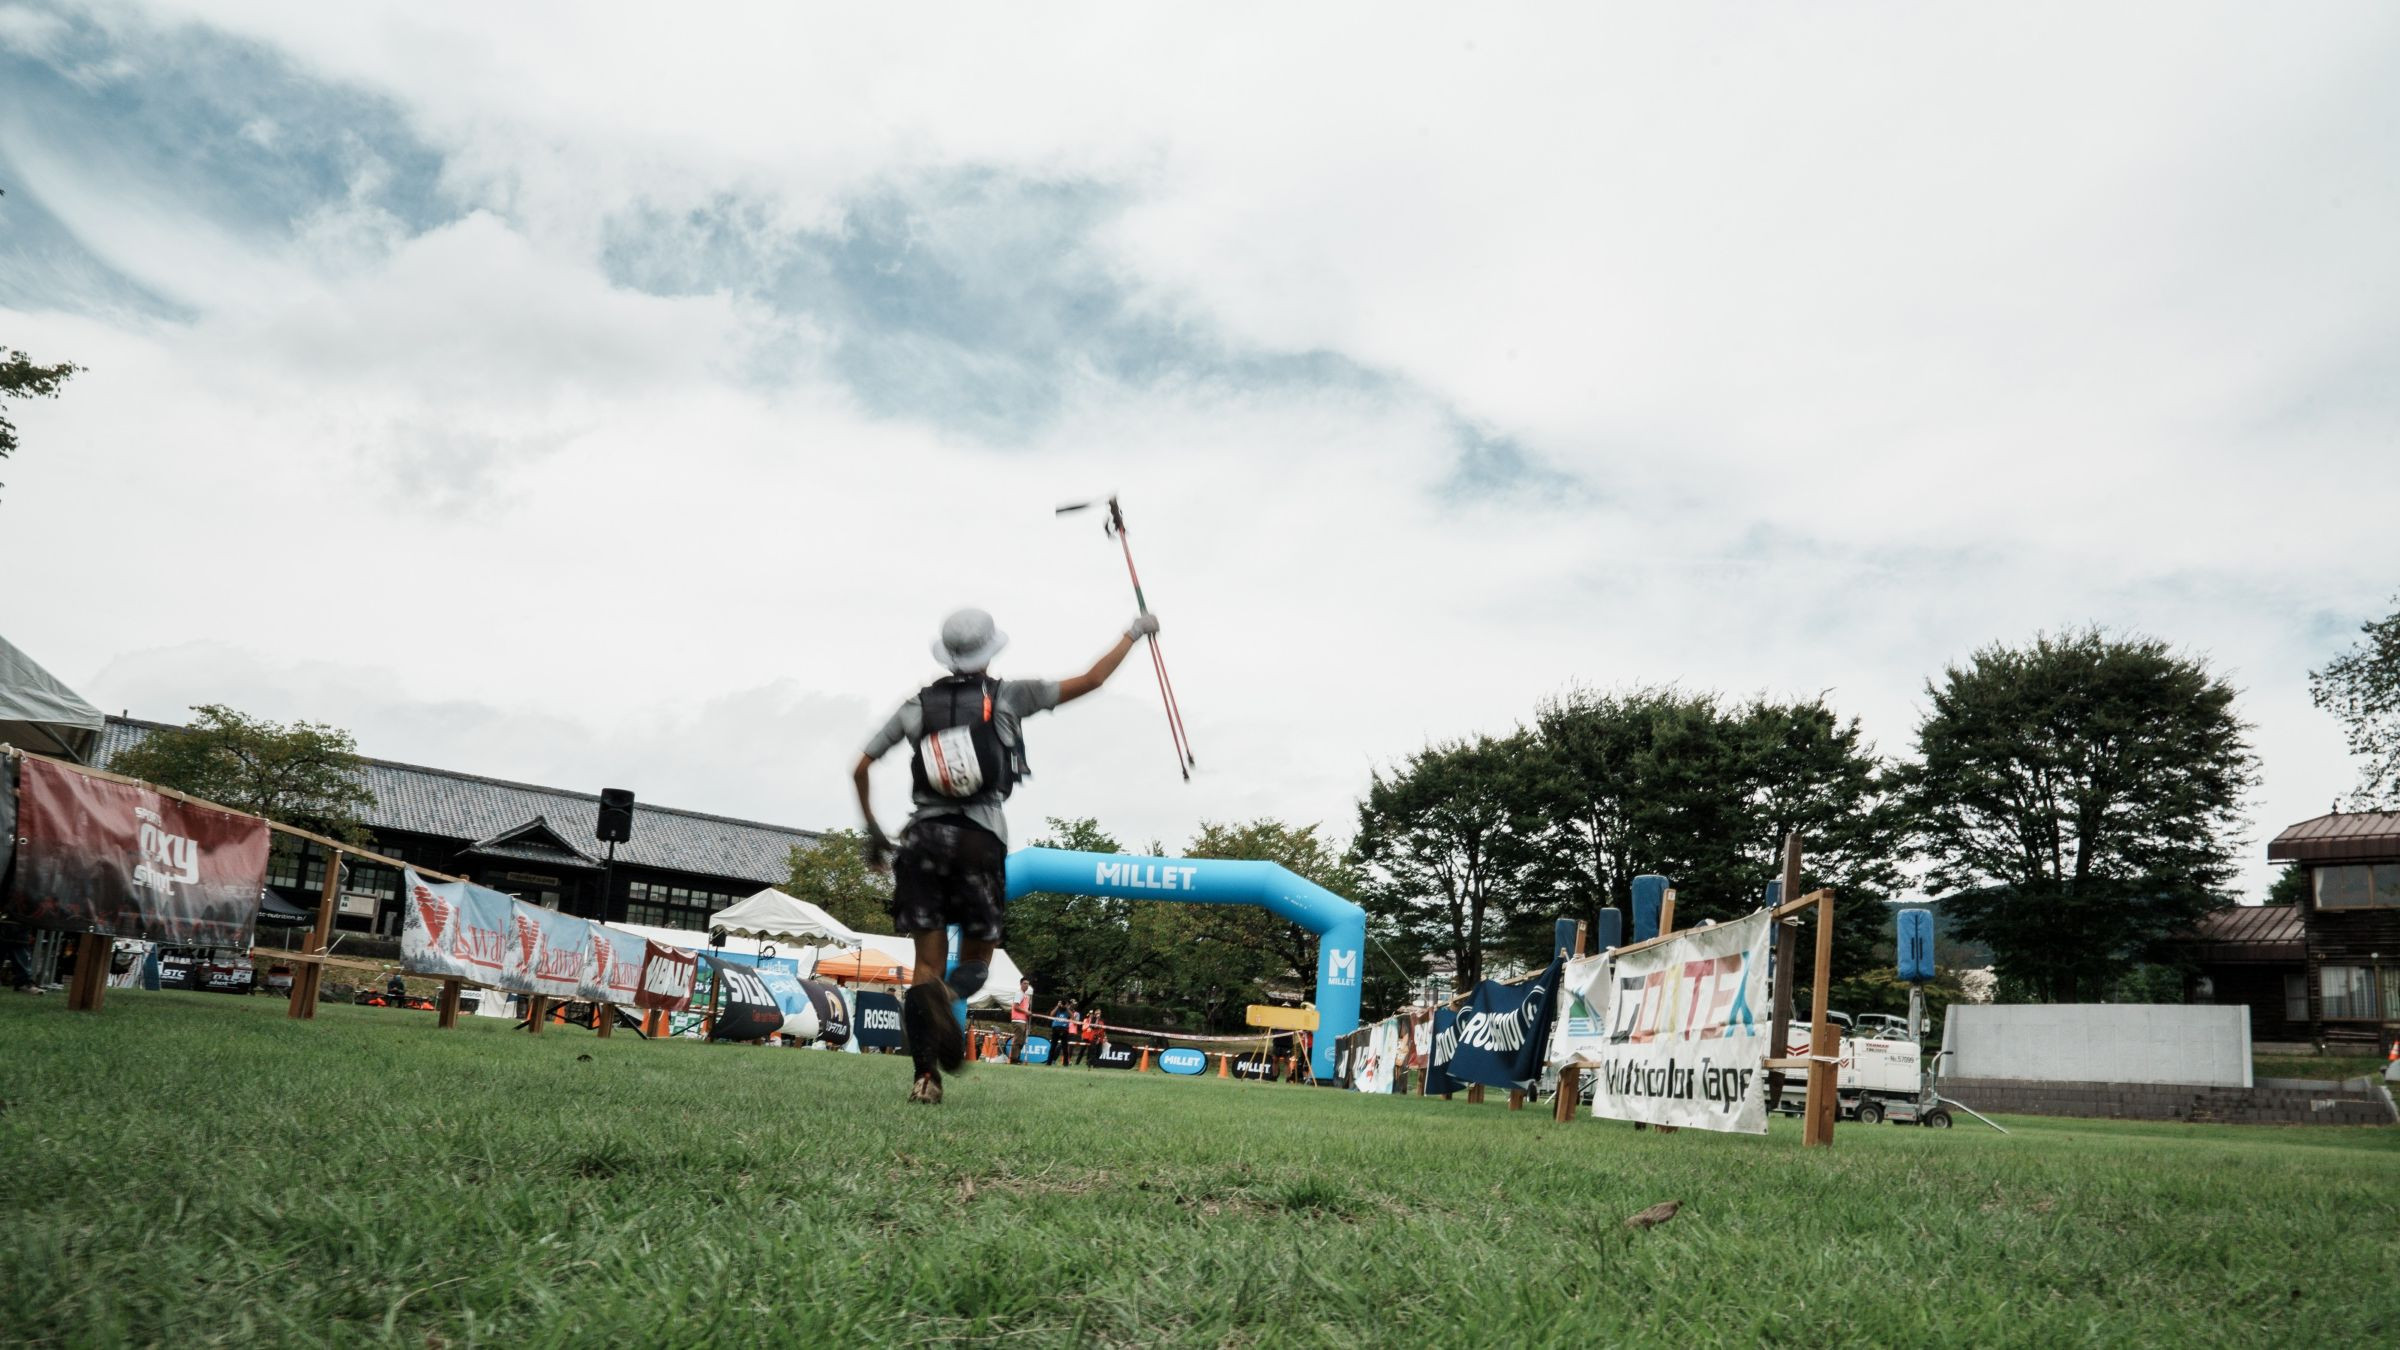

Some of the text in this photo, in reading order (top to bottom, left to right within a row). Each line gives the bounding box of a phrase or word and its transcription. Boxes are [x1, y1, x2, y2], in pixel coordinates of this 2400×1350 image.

[141, 823, 199, 885] oxy
[1096, 862, 1197, 890] MILLET
[1328, 977, 1355, 986] MILLET
[1164, 1055, 1200, 1067] MILLET
[1604, 1057, 1754, 1114] Multicolor Tape
